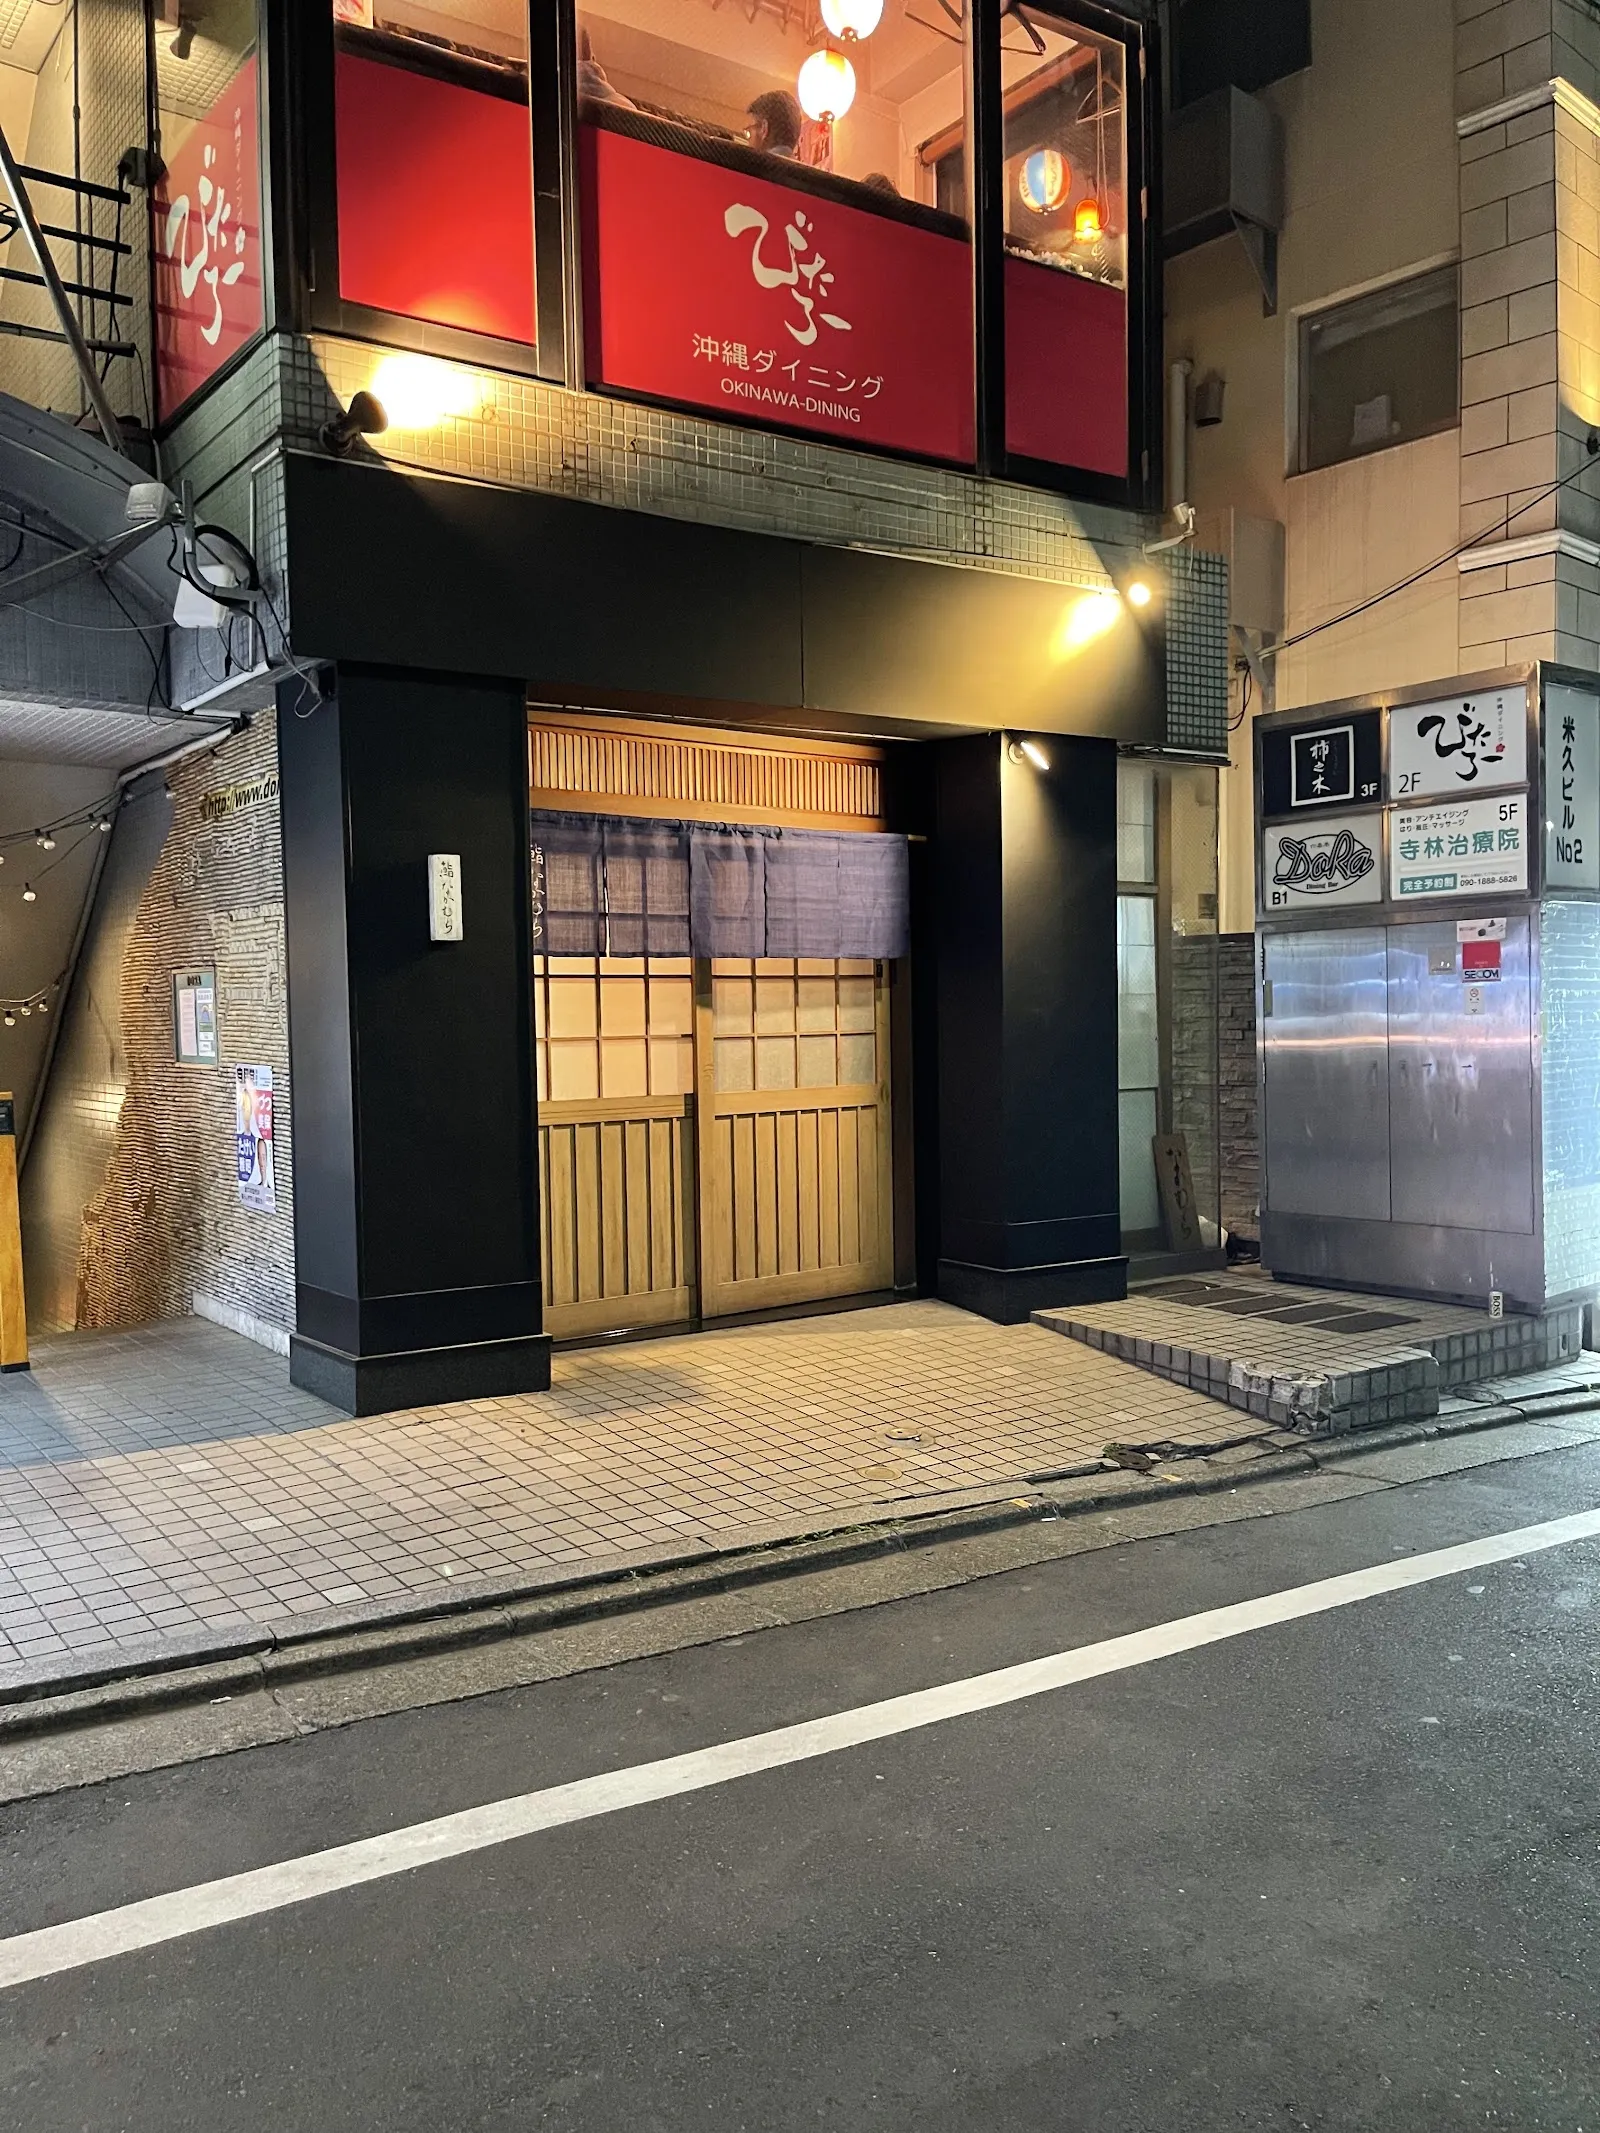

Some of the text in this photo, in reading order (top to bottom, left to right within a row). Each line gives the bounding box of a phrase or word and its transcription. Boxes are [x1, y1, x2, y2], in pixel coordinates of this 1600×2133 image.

[692, 333, 885, 399] 沖縄ダイニング
[721, 378, 861, 423] OKINAWA-DINING
[1399, 772, 1422, 794] 2F
[1561, 716, 1576, 830] 米久ビル
[1360, 783, 1378, 797] 3F
[1499, 803, 1518, 822] 5F
[1399, 828, 1519, 861] 寺林治療院
[1272, 891, 1288, 905] B1
[1464, 969, 1499, 980] SECOM
[1493, 1295, 1501, 1317] BOSS
